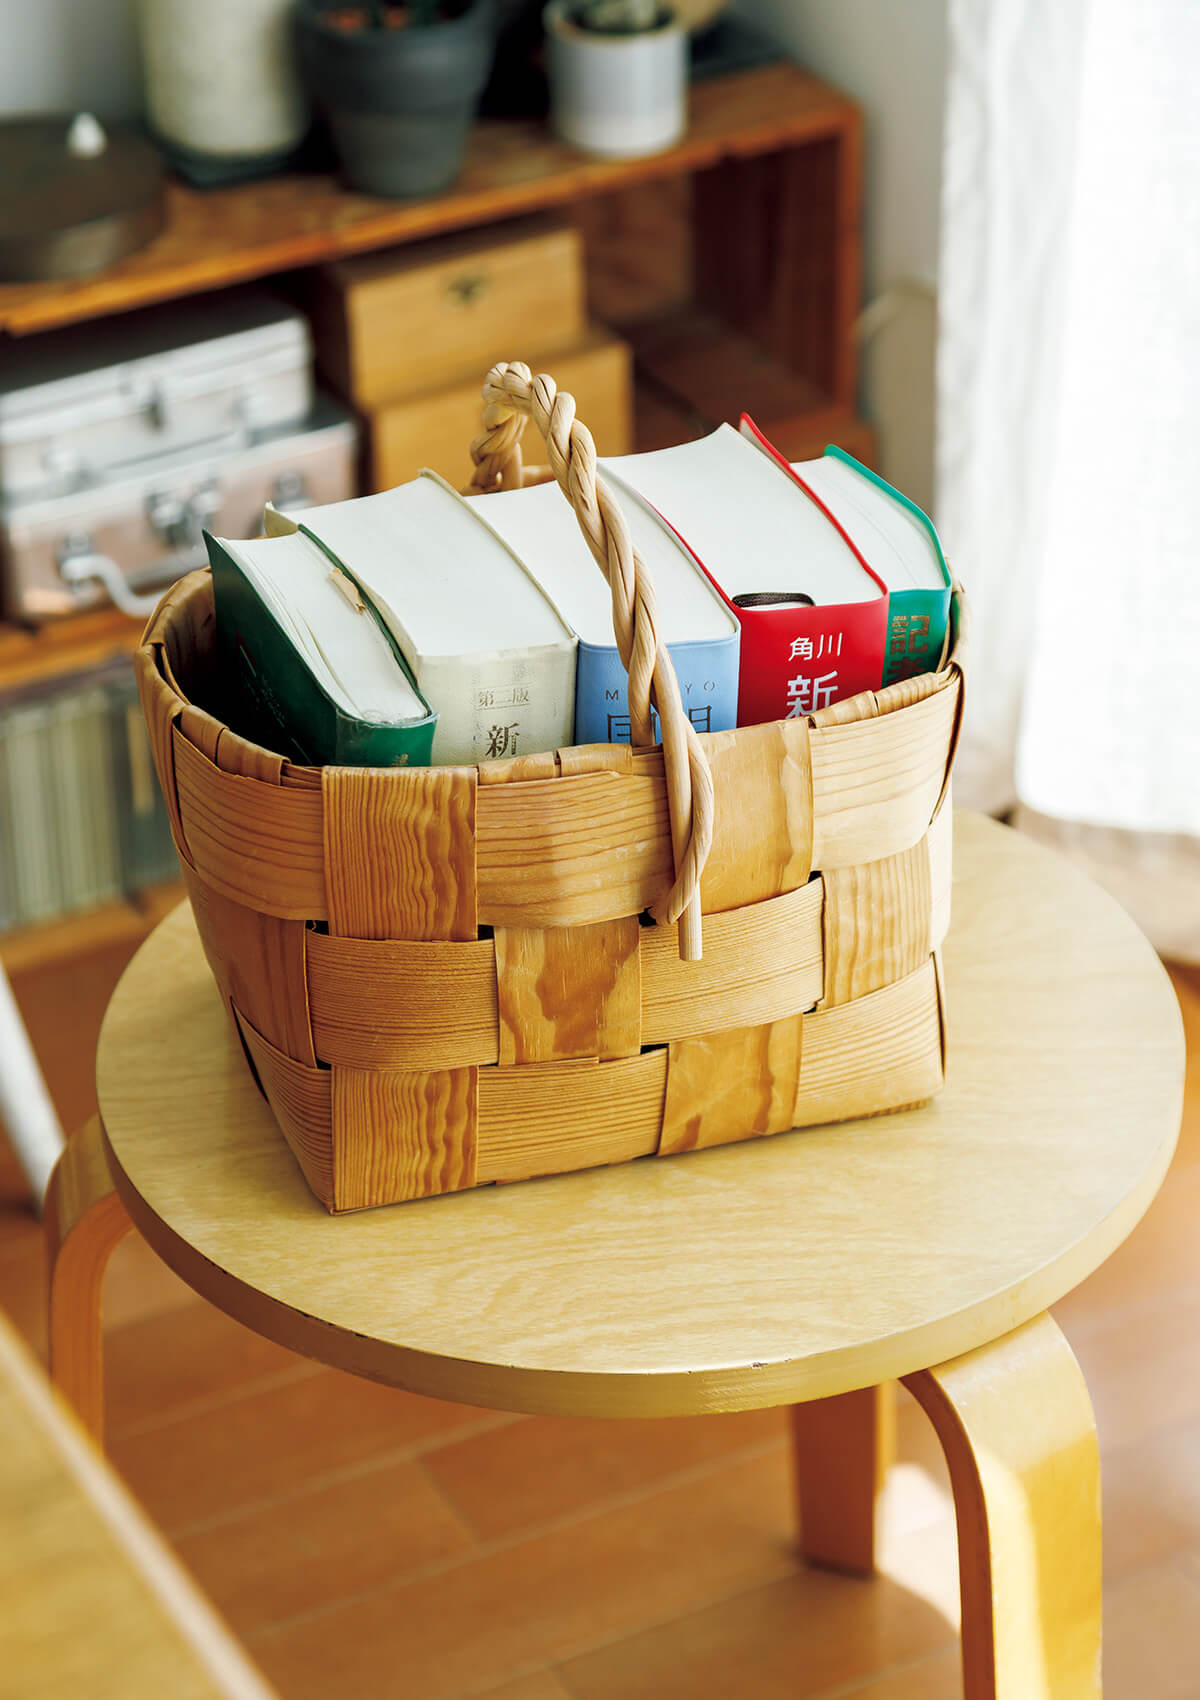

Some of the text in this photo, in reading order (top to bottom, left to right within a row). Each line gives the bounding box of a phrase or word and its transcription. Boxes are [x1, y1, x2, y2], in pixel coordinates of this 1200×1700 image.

[788, 632, 843, 662] 角川
[785, 670, 839, 720] 新
[485, 722, 520, 758] 新
